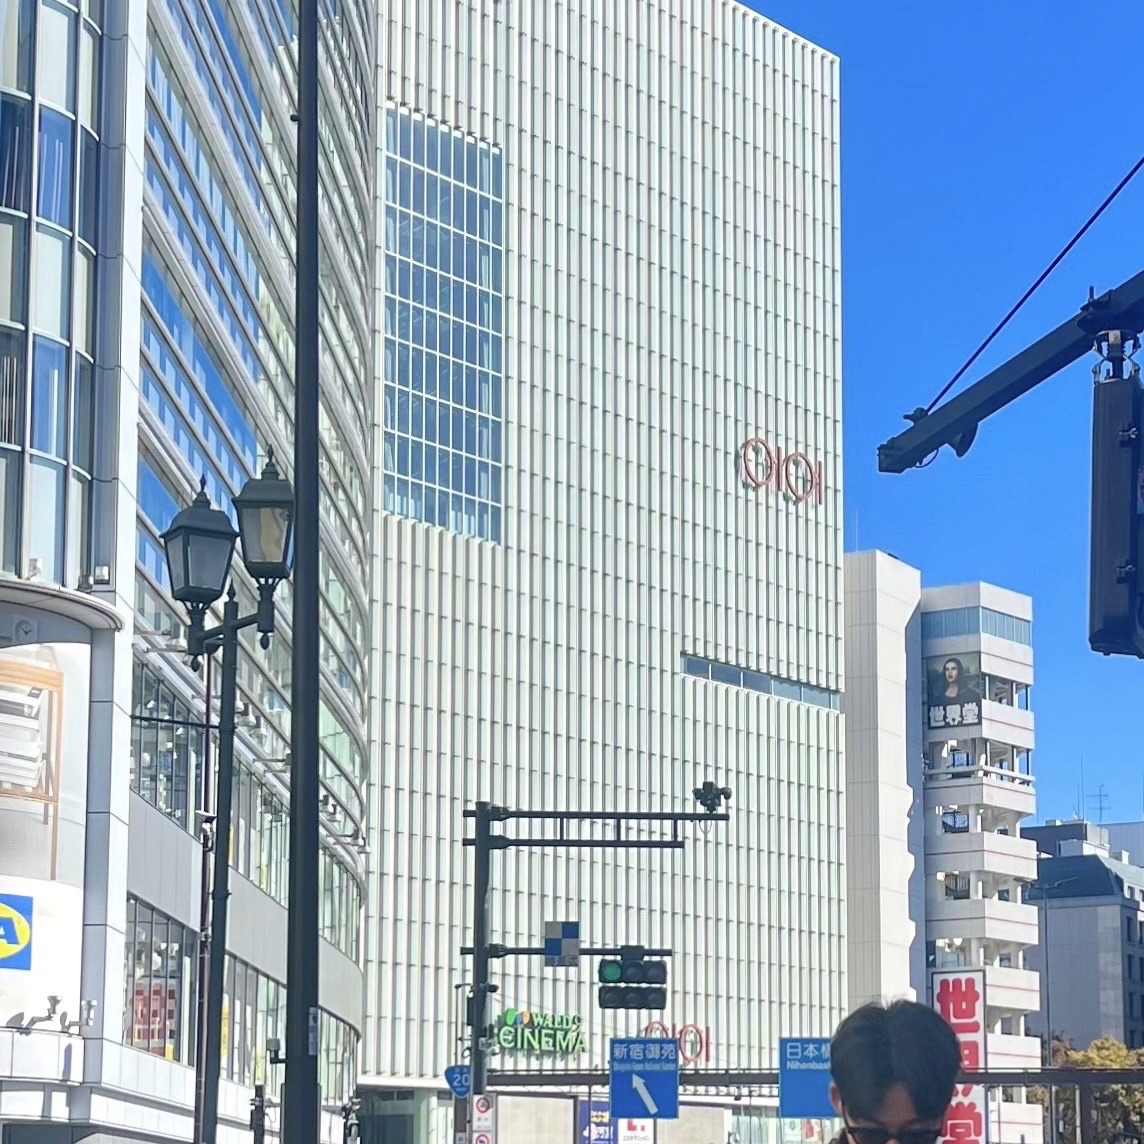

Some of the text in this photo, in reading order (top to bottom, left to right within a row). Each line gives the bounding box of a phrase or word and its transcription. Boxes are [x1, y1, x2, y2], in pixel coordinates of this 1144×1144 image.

[929, 702, 979, 727] 世界堂
[500, 1026, 588, 1053] CINEMA
[613, 1043, 677, 1060] 新宿御苑
[453, 1074, 470, 1087] 20
